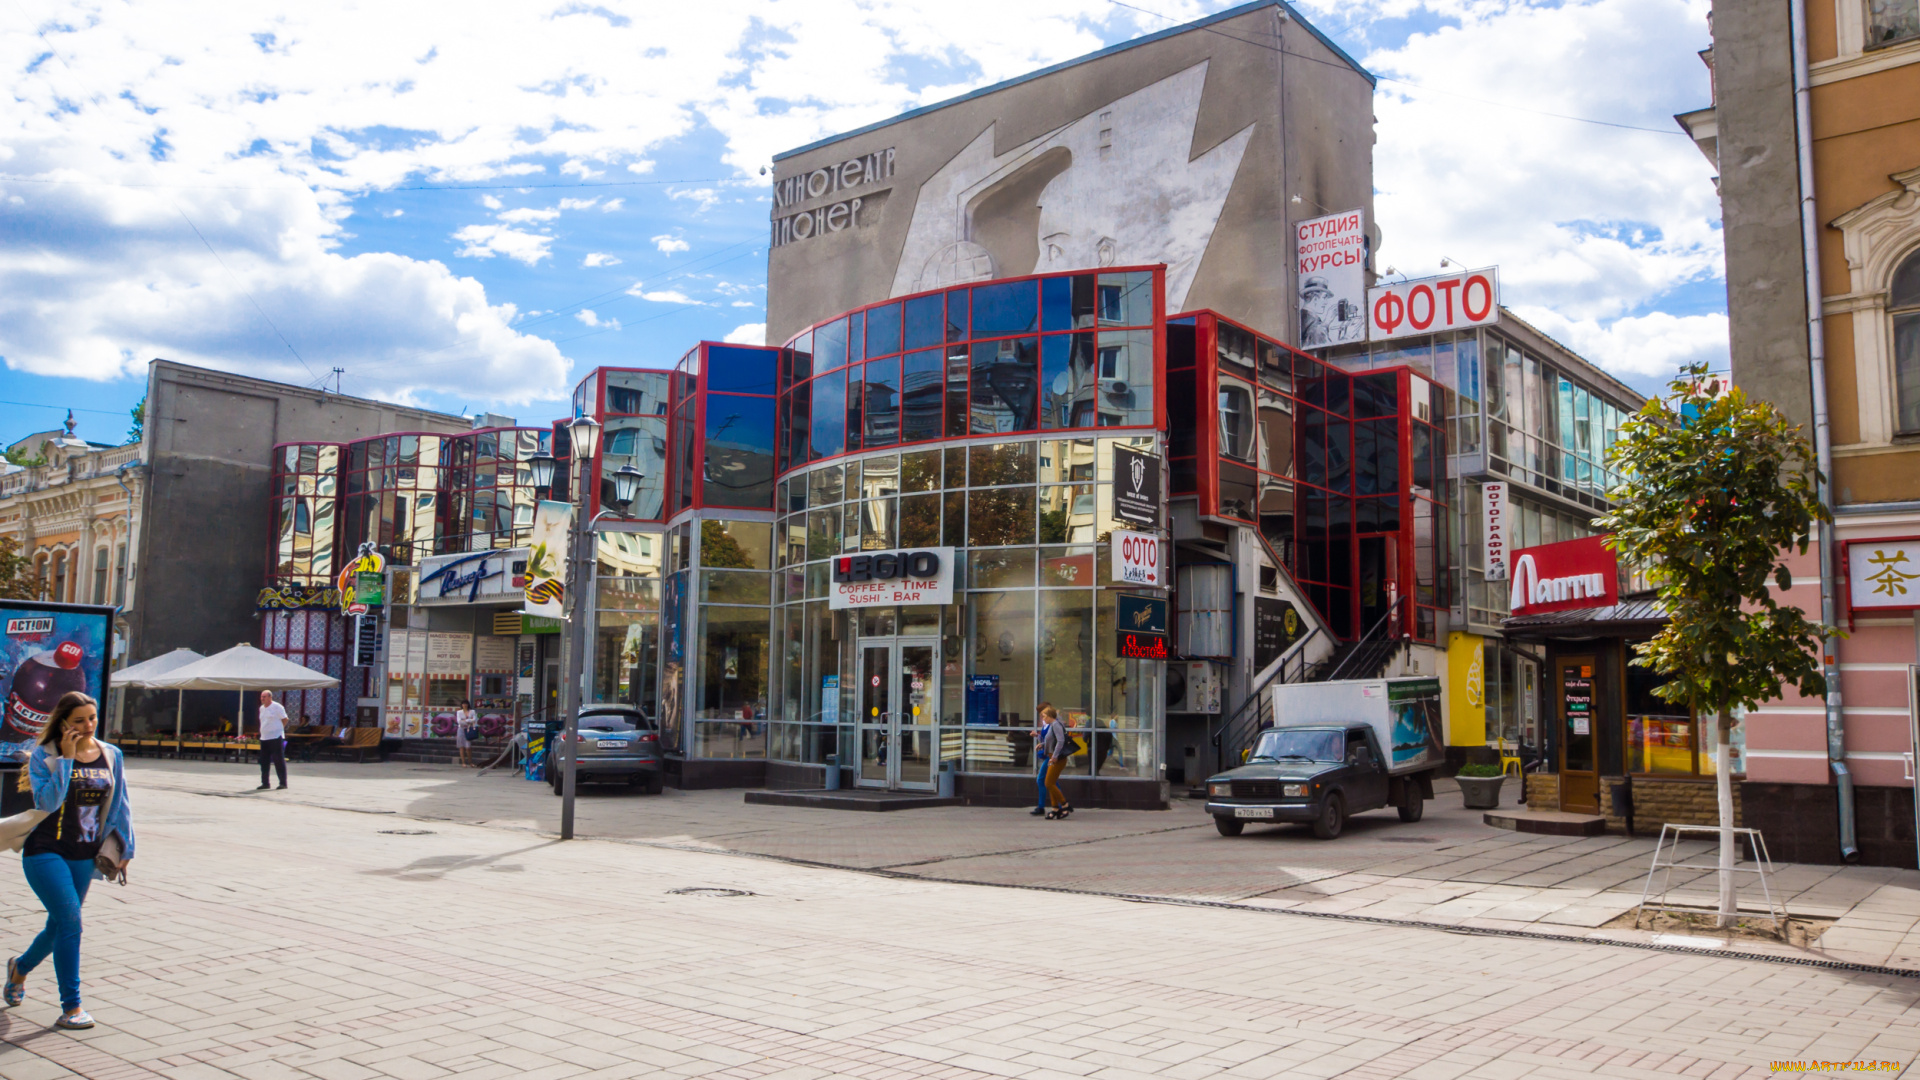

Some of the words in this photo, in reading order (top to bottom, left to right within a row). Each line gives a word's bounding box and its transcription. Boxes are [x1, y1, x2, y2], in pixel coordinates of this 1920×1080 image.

[1299, 215, 1359, 240] СТУДИЯ
[1299, 235, 1363, 254] ФОТОПЕЧАТЬ
[1300, 248, 1360, 274] КУРСЫ
[1374, 275, 1491, 334] ФОТО
[1486, 485, 1503, 564] ФОТОГРАФИЯ
[1122, 536, 1157, 567] ФОТО
[833, 551, 939, 582] LEGIO
[1864, 550, 1920, 597] 茶
[839, 583, 886, 594] COFFEE
[901, 580, 938, 590] TIME
[1511, 554, 1606, 610] Лапти
[849, 594, 880, 604] SUSHI
[893, 592, 920, 602] BAR
[62, 644, 81, 656] GO!
